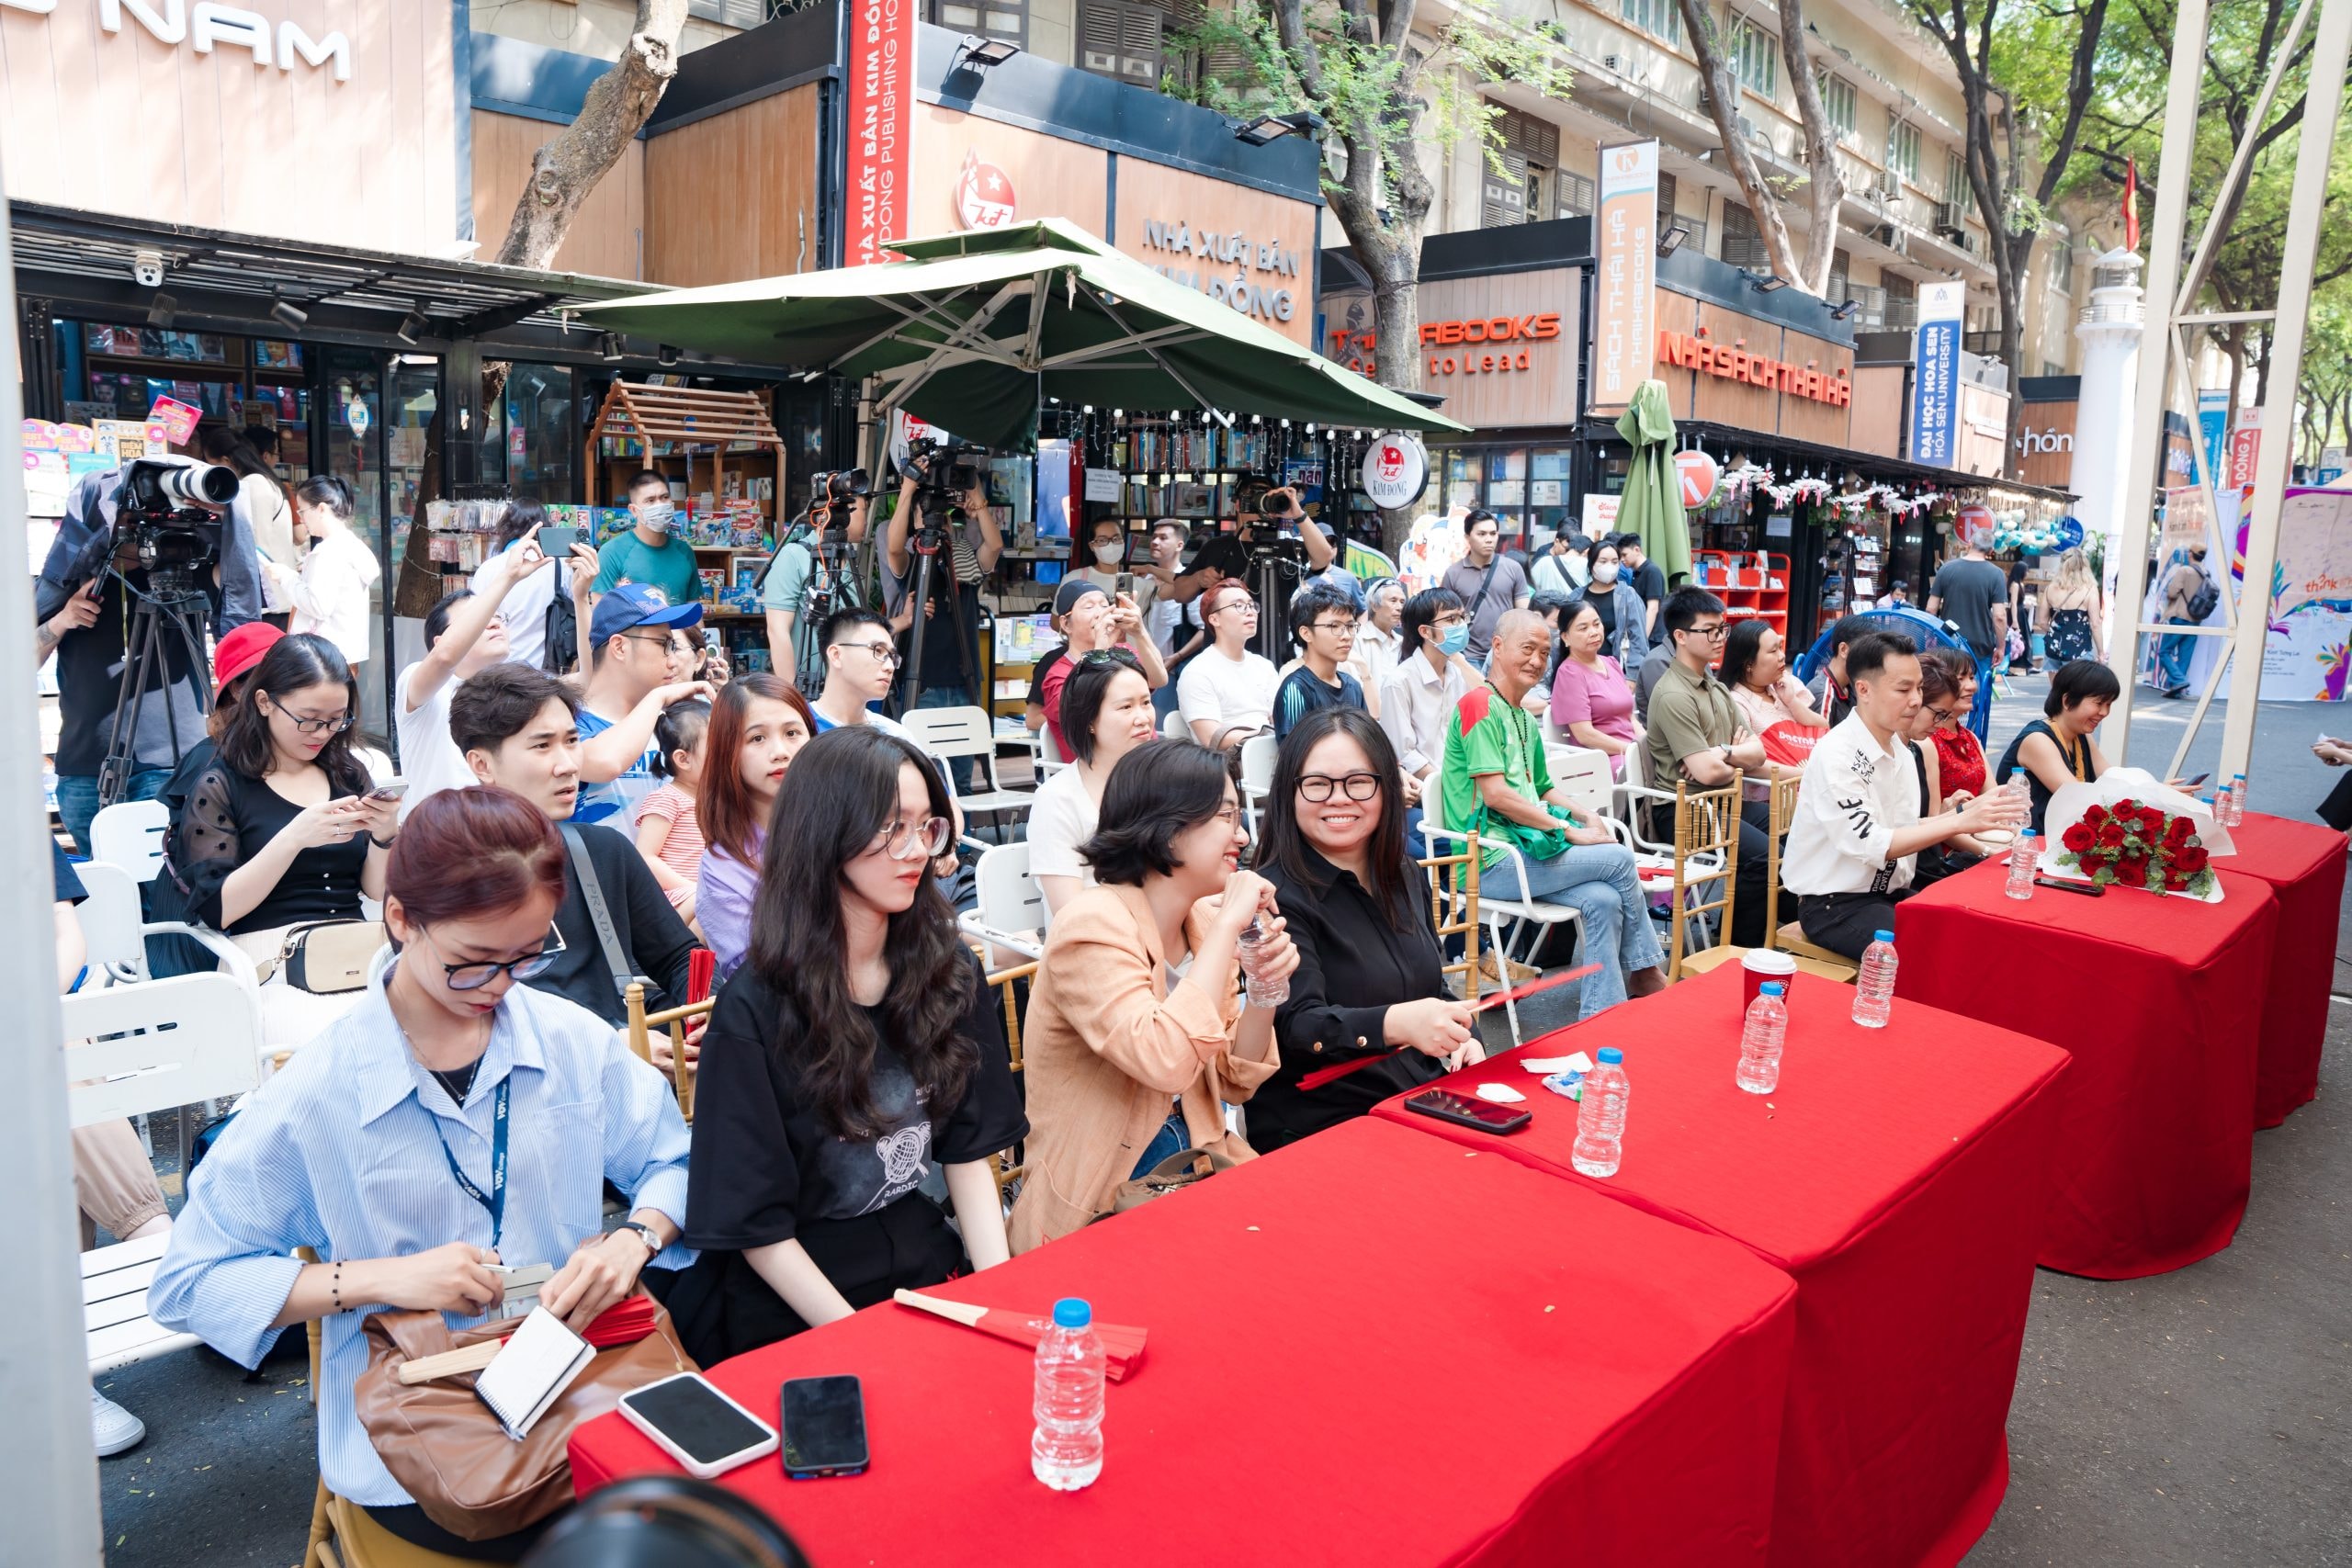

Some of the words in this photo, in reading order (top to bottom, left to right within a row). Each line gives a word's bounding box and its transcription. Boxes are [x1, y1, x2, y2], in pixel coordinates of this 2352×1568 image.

[865, 50, 880, 98] KIM
[881, 39, 898, 164] PUBLISHING
[860, 105, 878, 157] BẢN
[859, 165, 876, 229] XUẤT
[859, 232, 875, 265] HÀ
[1143, 220, 1193, 256] NHÀ
[1256, 237, 1297, 278] BẢN
[1927, 326, 1939, 357] SEN
[1430, 355, 1457, 376] to
[1464, 346, 1532, 375] Lead
[1925, 361, 1937, 391] HOA
[1938, 326, 1951, 400] UNIVERSITY
[1922, 397, 1937, 428] HỌC
[1936, 405, 1947, 427] SEN
[1920, 431, 1935, 458] ĐẠI
[1934, 431, 1946, 458] HOA
[586, 883, 614, 945] PRADA
[495, 1168, 504, 1190] VOV
